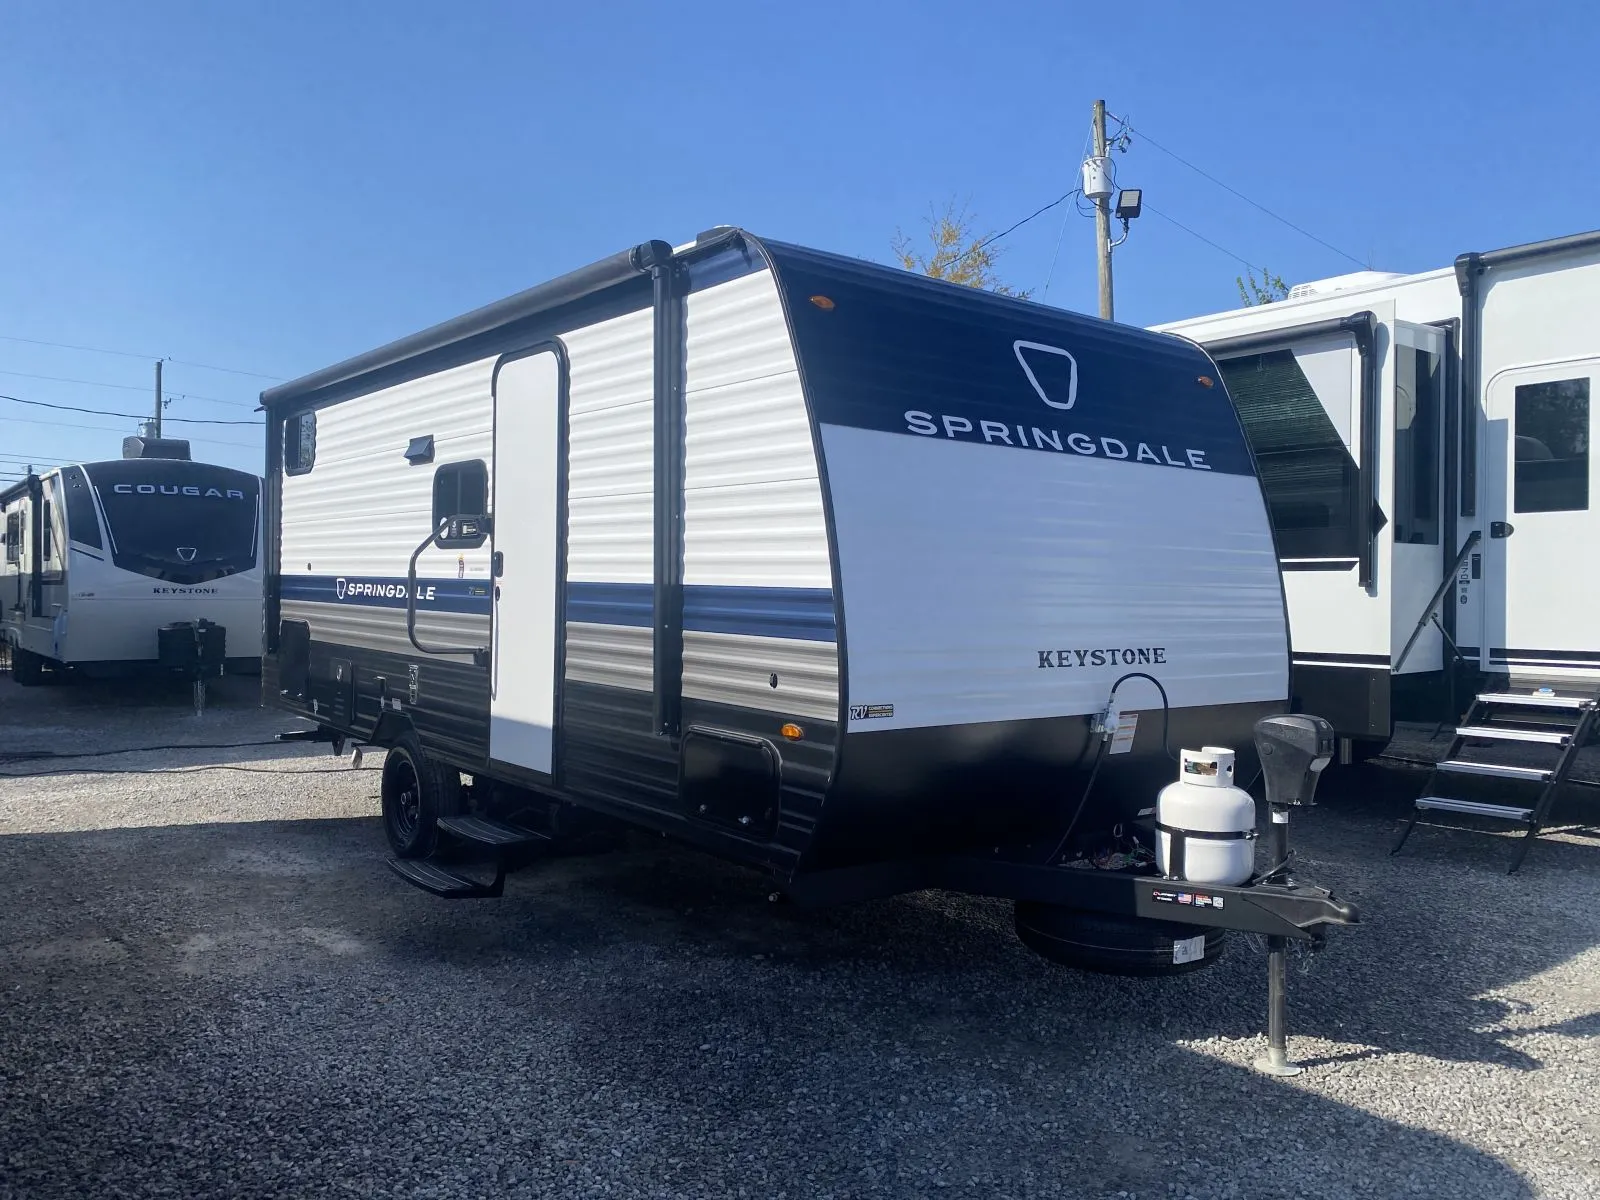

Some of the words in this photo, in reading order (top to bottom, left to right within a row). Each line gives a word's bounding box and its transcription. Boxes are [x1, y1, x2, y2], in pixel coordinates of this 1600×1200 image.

[904, 410, 1211, 470] SPRINGDALE
[113, 484, 244, 499] COUGAR
[347, 583, 436, 600] SPRINGDLE
[1037, 647, 1167, 668] KEYSTONE
[851, 705, 868, 720] RV
